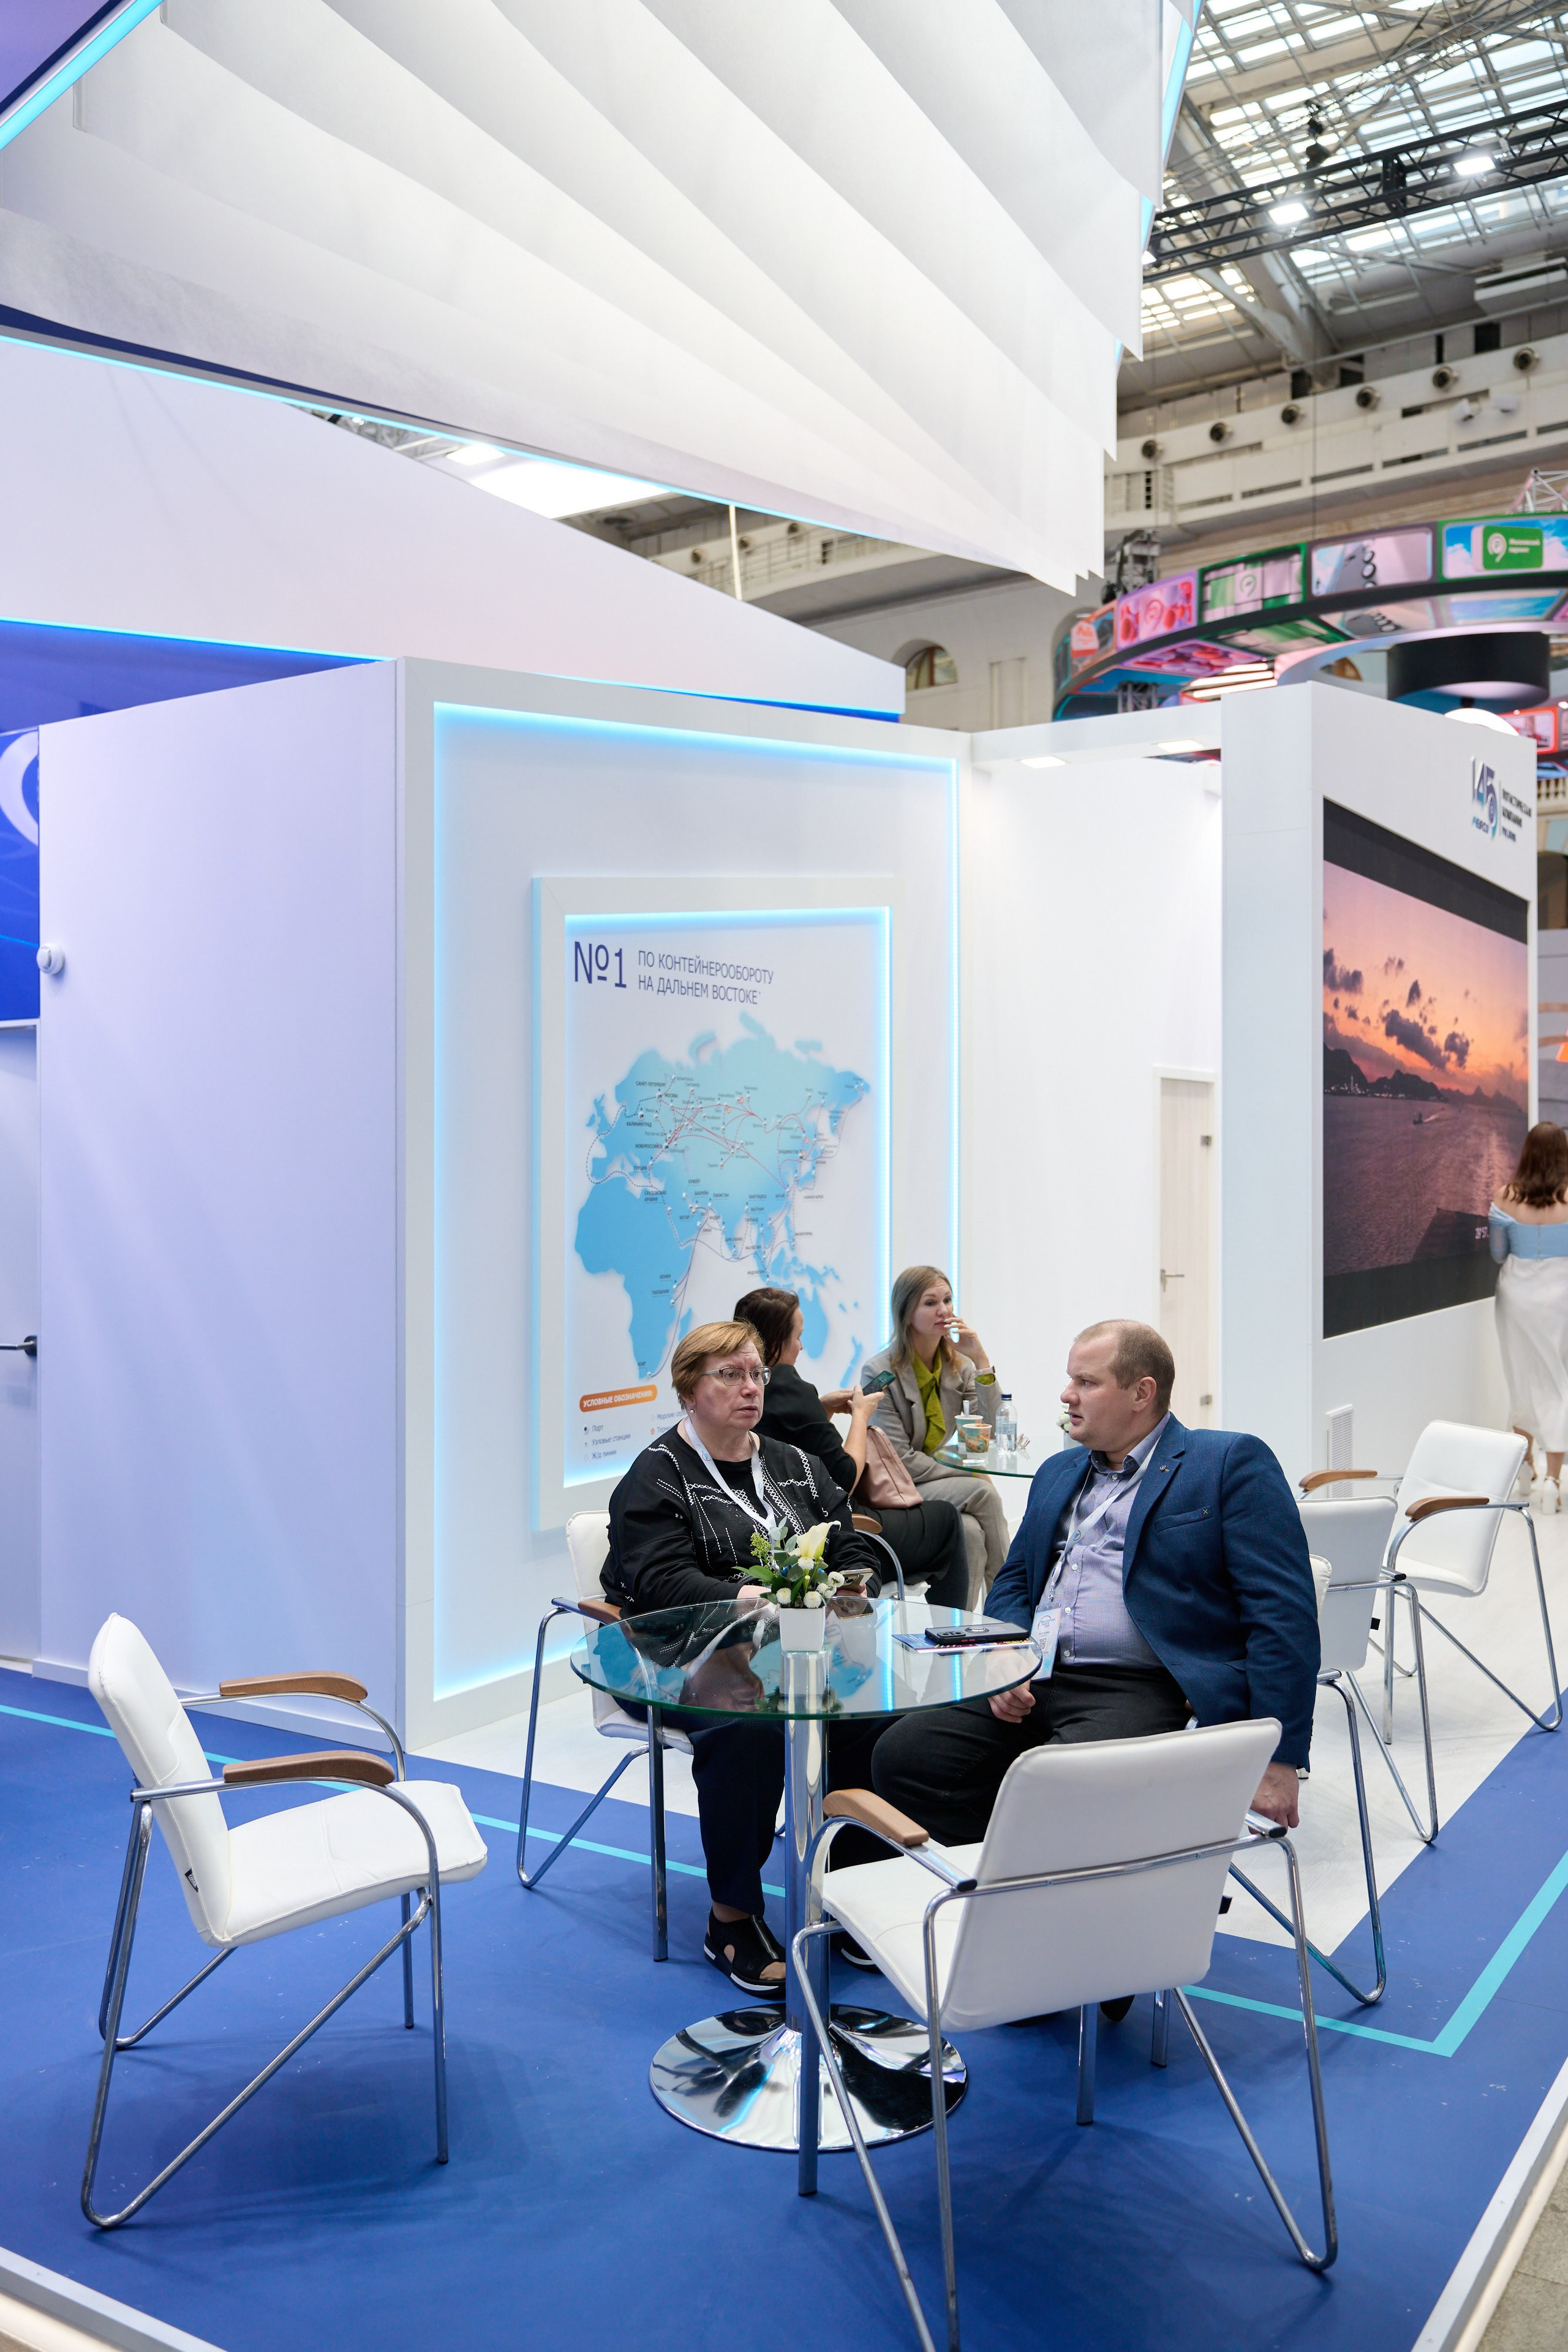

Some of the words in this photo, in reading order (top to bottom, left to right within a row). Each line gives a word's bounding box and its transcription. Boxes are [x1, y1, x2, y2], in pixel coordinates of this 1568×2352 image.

[639, 950, 655, 967] ПО
[658, 954, 774, 984] КОНТЕЙНЕРООБОРОТУ
[639, 974, 654, 991] НА
[657, 977, 709, 998] ДАЛЬНЕМ
[583, 1396, 612, 1408] УСЛОВНЫЕ
[614, 1390, 654, 1403] ОБОЗНАЧЕНИЯ:
[592, 1436, 611, 1446] Узловые
